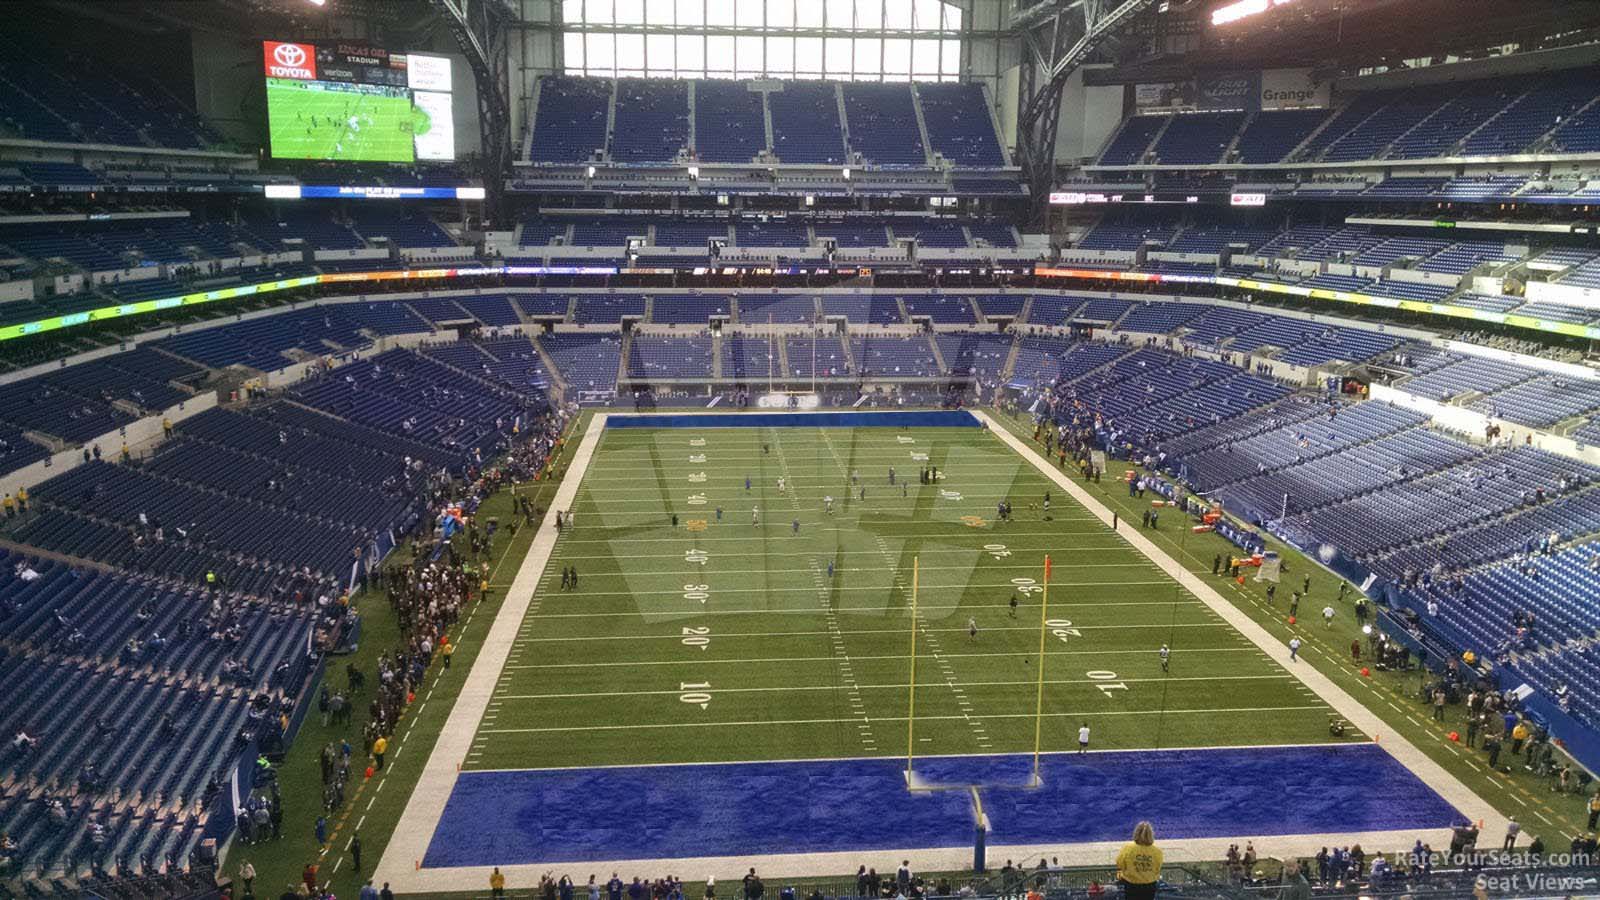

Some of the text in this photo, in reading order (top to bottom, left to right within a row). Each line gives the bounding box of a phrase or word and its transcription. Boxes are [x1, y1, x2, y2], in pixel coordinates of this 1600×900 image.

[347, 56, 379, 65] STADIUM
[269, 66, 312, 78] TOYOTA
[324, 69, 352, 77] verizon
[1263, 89, 1314, 102] Grange
[685, 549, 708, 562] 40
[983, 544, 1012, 557] 40
[683, 584, 709, 599] 30
[1010, 577, 1043, 592] 30
[1045, 619, 1082, 637] 20
[681, 626, 710, 645] 20
[1086, 670, 1129, 691] 10
[679, 681, 711, 703] 10
